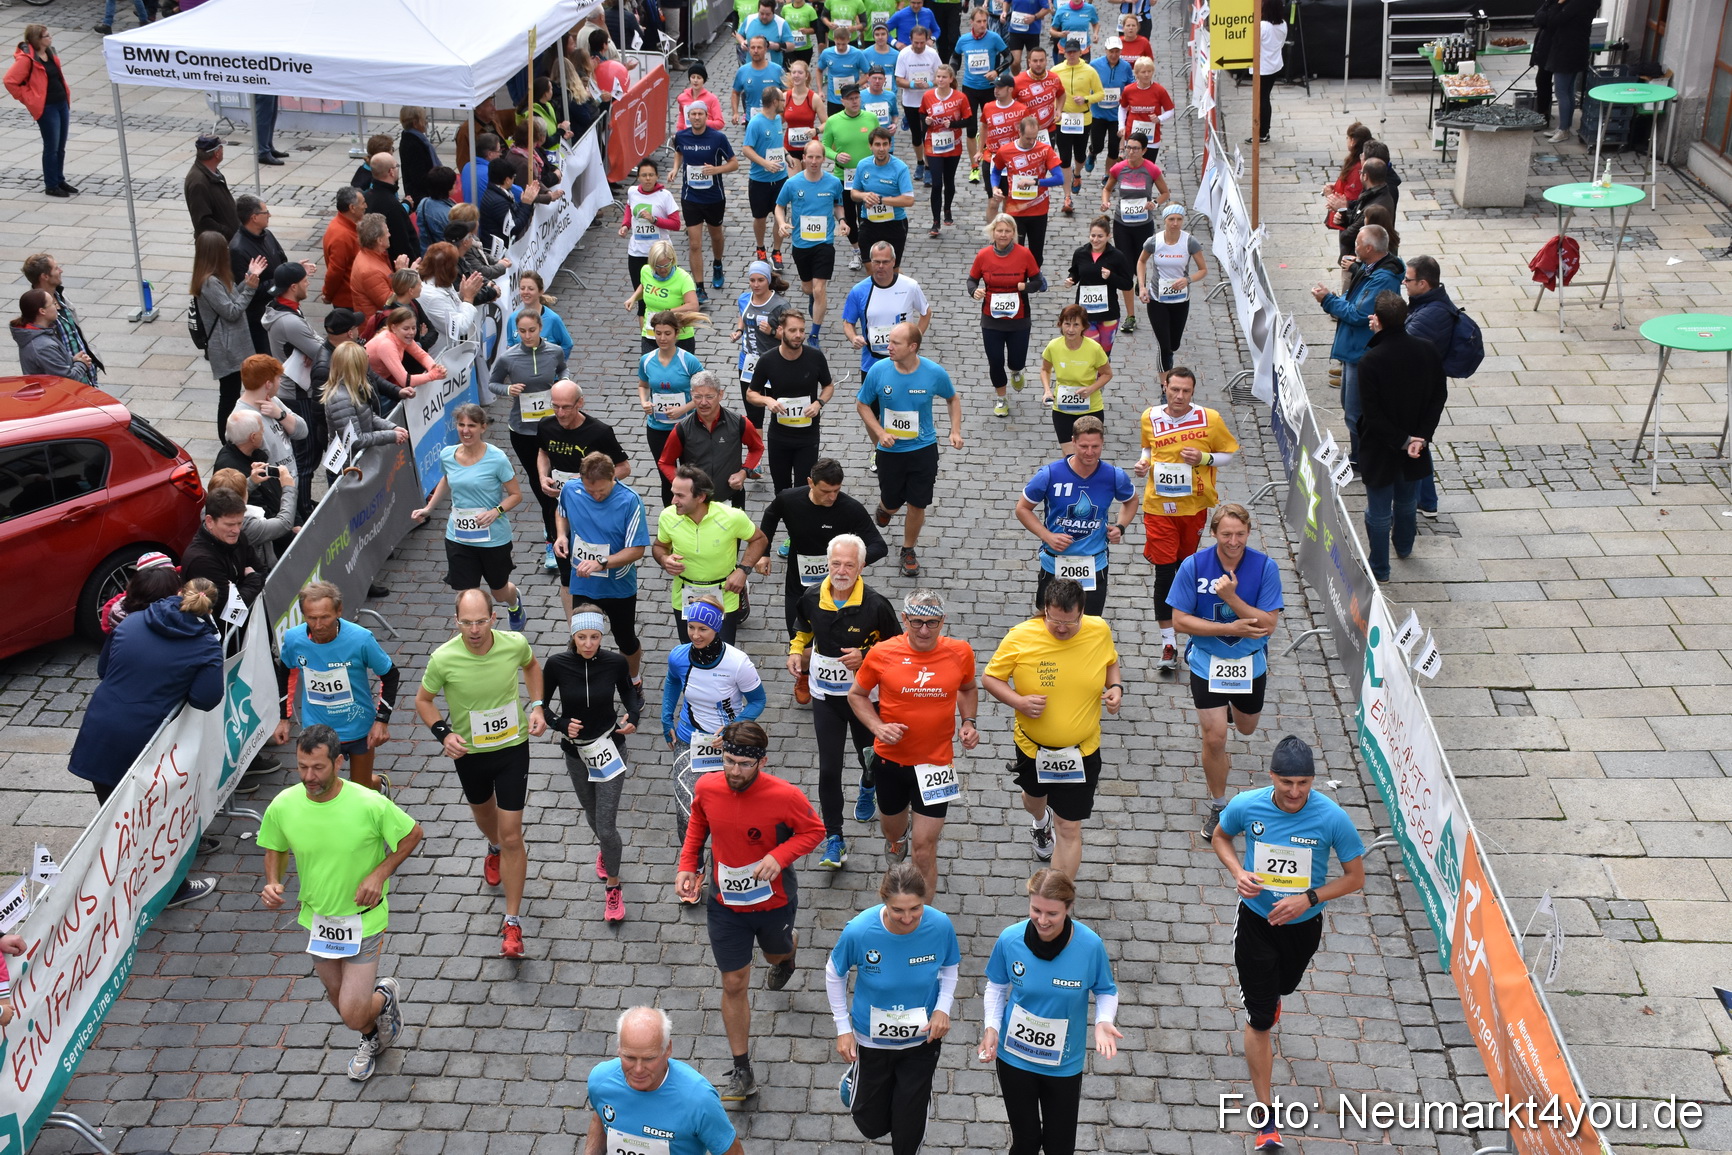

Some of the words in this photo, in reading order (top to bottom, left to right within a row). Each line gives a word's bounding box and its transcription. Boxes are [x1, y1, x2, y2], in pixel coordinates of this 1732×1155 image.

[1212, 14, 1254, 28] Jugend
[1225, 28, 1246, 40] lauf
[123, 46, 170, 64] BMW
[176, 50, 312, 74] ConnectedDrive
[126, 64, 180, 80] Vernetzt,
[183, 72, 200, 80] um
[204, 70, 223, 82] frei
[242, 74, 270, 84] sein.
[872, 205, 887, 214] 184
[1124, 206, 1143, 214] 2632
[806, 224, 820, 232] 409
[645, 284, 668, 298] EKS
[1084, 294, 1103, 303] 2034
[995, 302, 1015, 310] 2529
[874, 335, 890, 343] 213
[532, 400, 545, 410] 12
[1062, 394, 1085, 404] 2255
[786, 407, 803, 417] 117
[892, 420, 910, 430] 408
[1155, 436, 1176, 448] MAX
[1182, 430, 1208, 442] BÖGL
[548, 440, 574, 455] RUN
[1320, 446, 1331, 460] sw
[1159, 474, 1185, 484] 2611
[1053, 483, 1073, 496] 11
[1061, 566, 1089, 578] 2086
[1423, 649, 1437, 671] swn
[818, 667, 847, 681] 2212
[1216, 665, 1246, 678] 2383
[310, 678, 343, 692] 2316
[722, 698, 736, 722] HUBE
[483, 717, 508, 732] 195
[485, 731, 508, 741] Alexander
[697, 746, 722, 756] 206
[1042, 760, 1076, 772] 2462
[925, 769, 954, 788] 2924
[1290, 836, 1317, 845] BOCK
[1267, 859, 1297, 874] 273
[724, 877, 758, 891] 2927
[319, 924, 353, 940] 2601
[909, 954, 935, 965] BOCK
[1053, 978, 1081, 987] BOCK
[63, 988, 114, 1072] Service-Line:
[878, 1023, 919, 1038] 2367
[1015, 1023, 1056, 1048] 2368
[1014, 1041, 1052, 1057] Tamara-Lilian
[643, 1126, 675, 1139] BOCK
